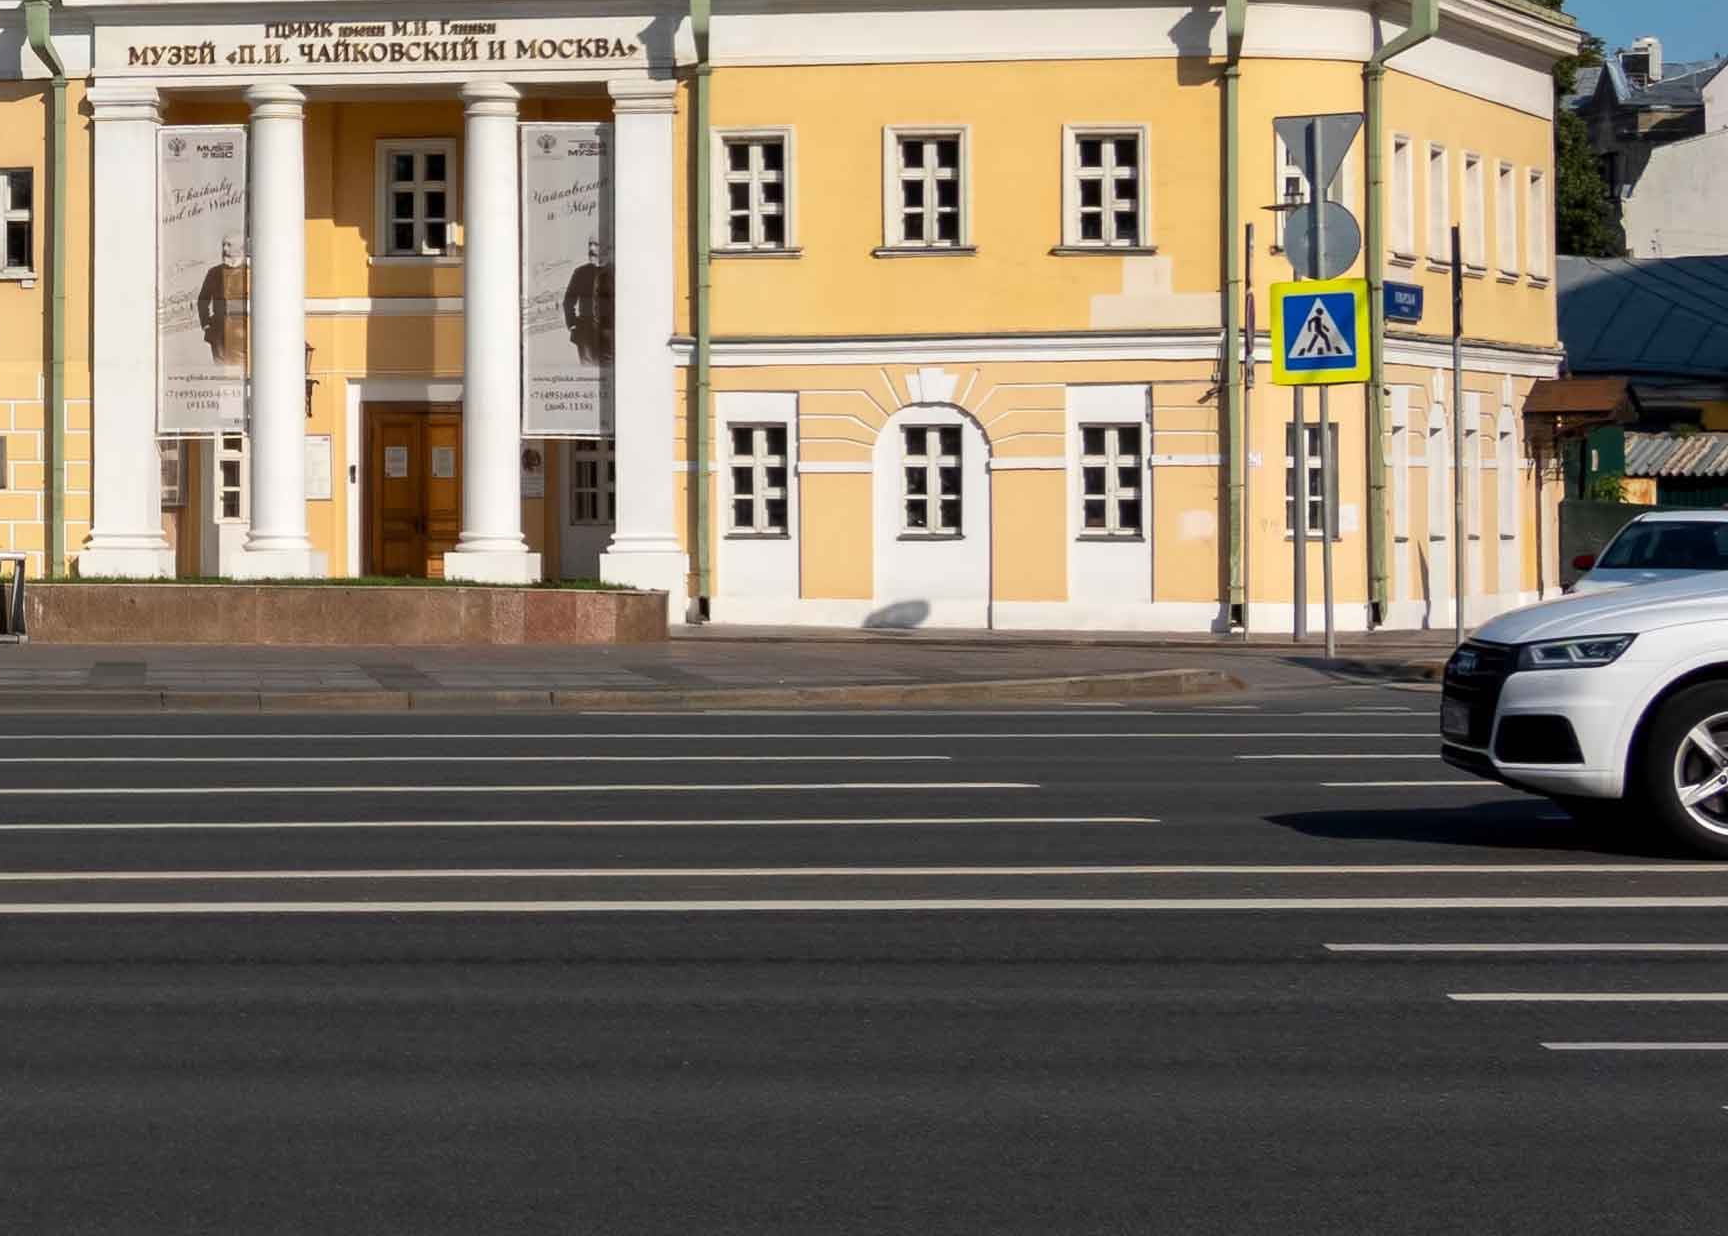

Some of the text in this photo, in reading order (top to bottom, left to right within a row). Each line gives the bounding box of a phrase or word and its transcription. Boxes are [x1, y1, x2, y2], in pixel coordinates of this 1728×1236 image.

[264, 21, 333, 39] ГЦММК
[128, 41, 216, 65] МУЗЕЙ
[298, 37, 479, 63] ЧАЙКОВСКИЙ
[487, 39, 506, 60] И
[515, 37, 638, 59] МОСКВА»
